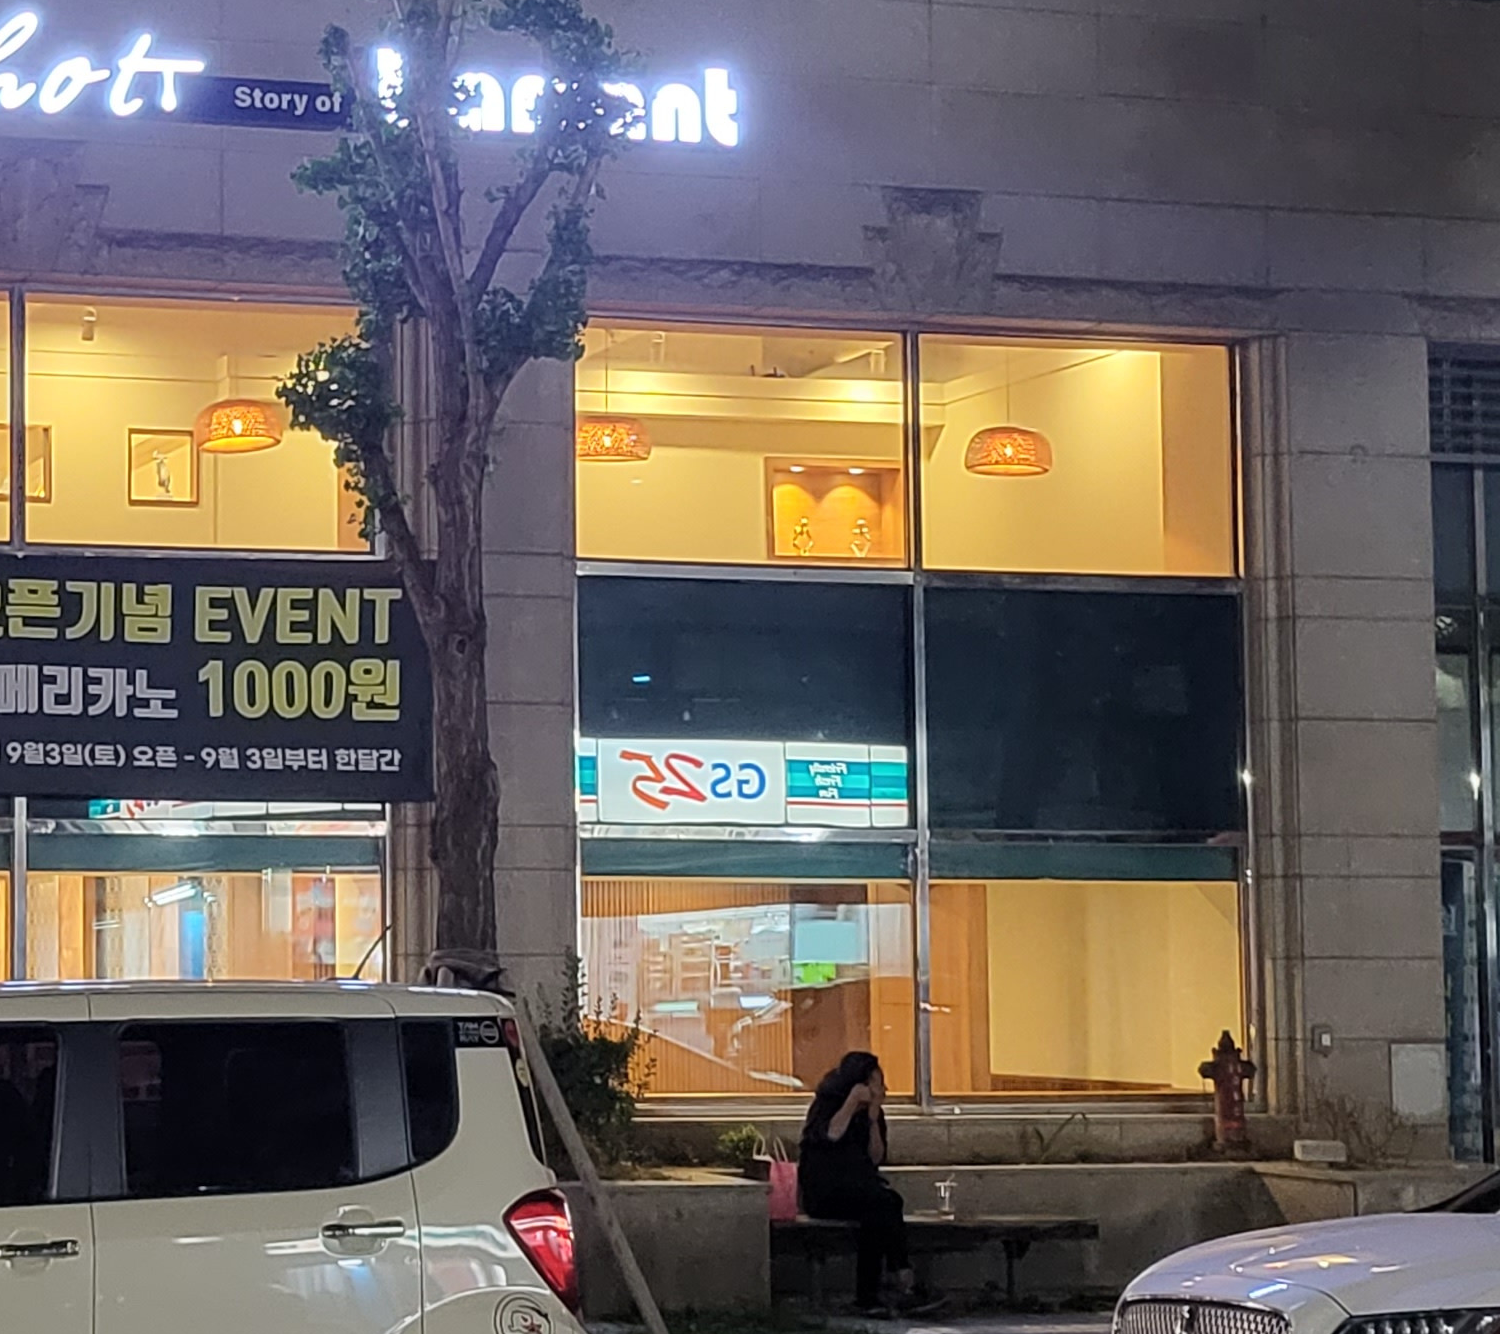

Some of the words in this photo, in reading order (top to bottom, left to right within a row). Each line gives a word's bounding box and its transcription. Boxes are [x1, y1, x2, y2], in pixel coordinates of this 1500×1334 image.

[234, 86, 308, 116] Story
[315, 91, 342, 113] of
[194, 585, 403, 645] EVENT
[197, 658, 401, 722] 1000원
[132, 746, 178, 768] 오픈
[200, 747, 240, 770] 9월
[246, 748, 328, 771] 3일부터
[334, 748, 401, 772] 한달간
